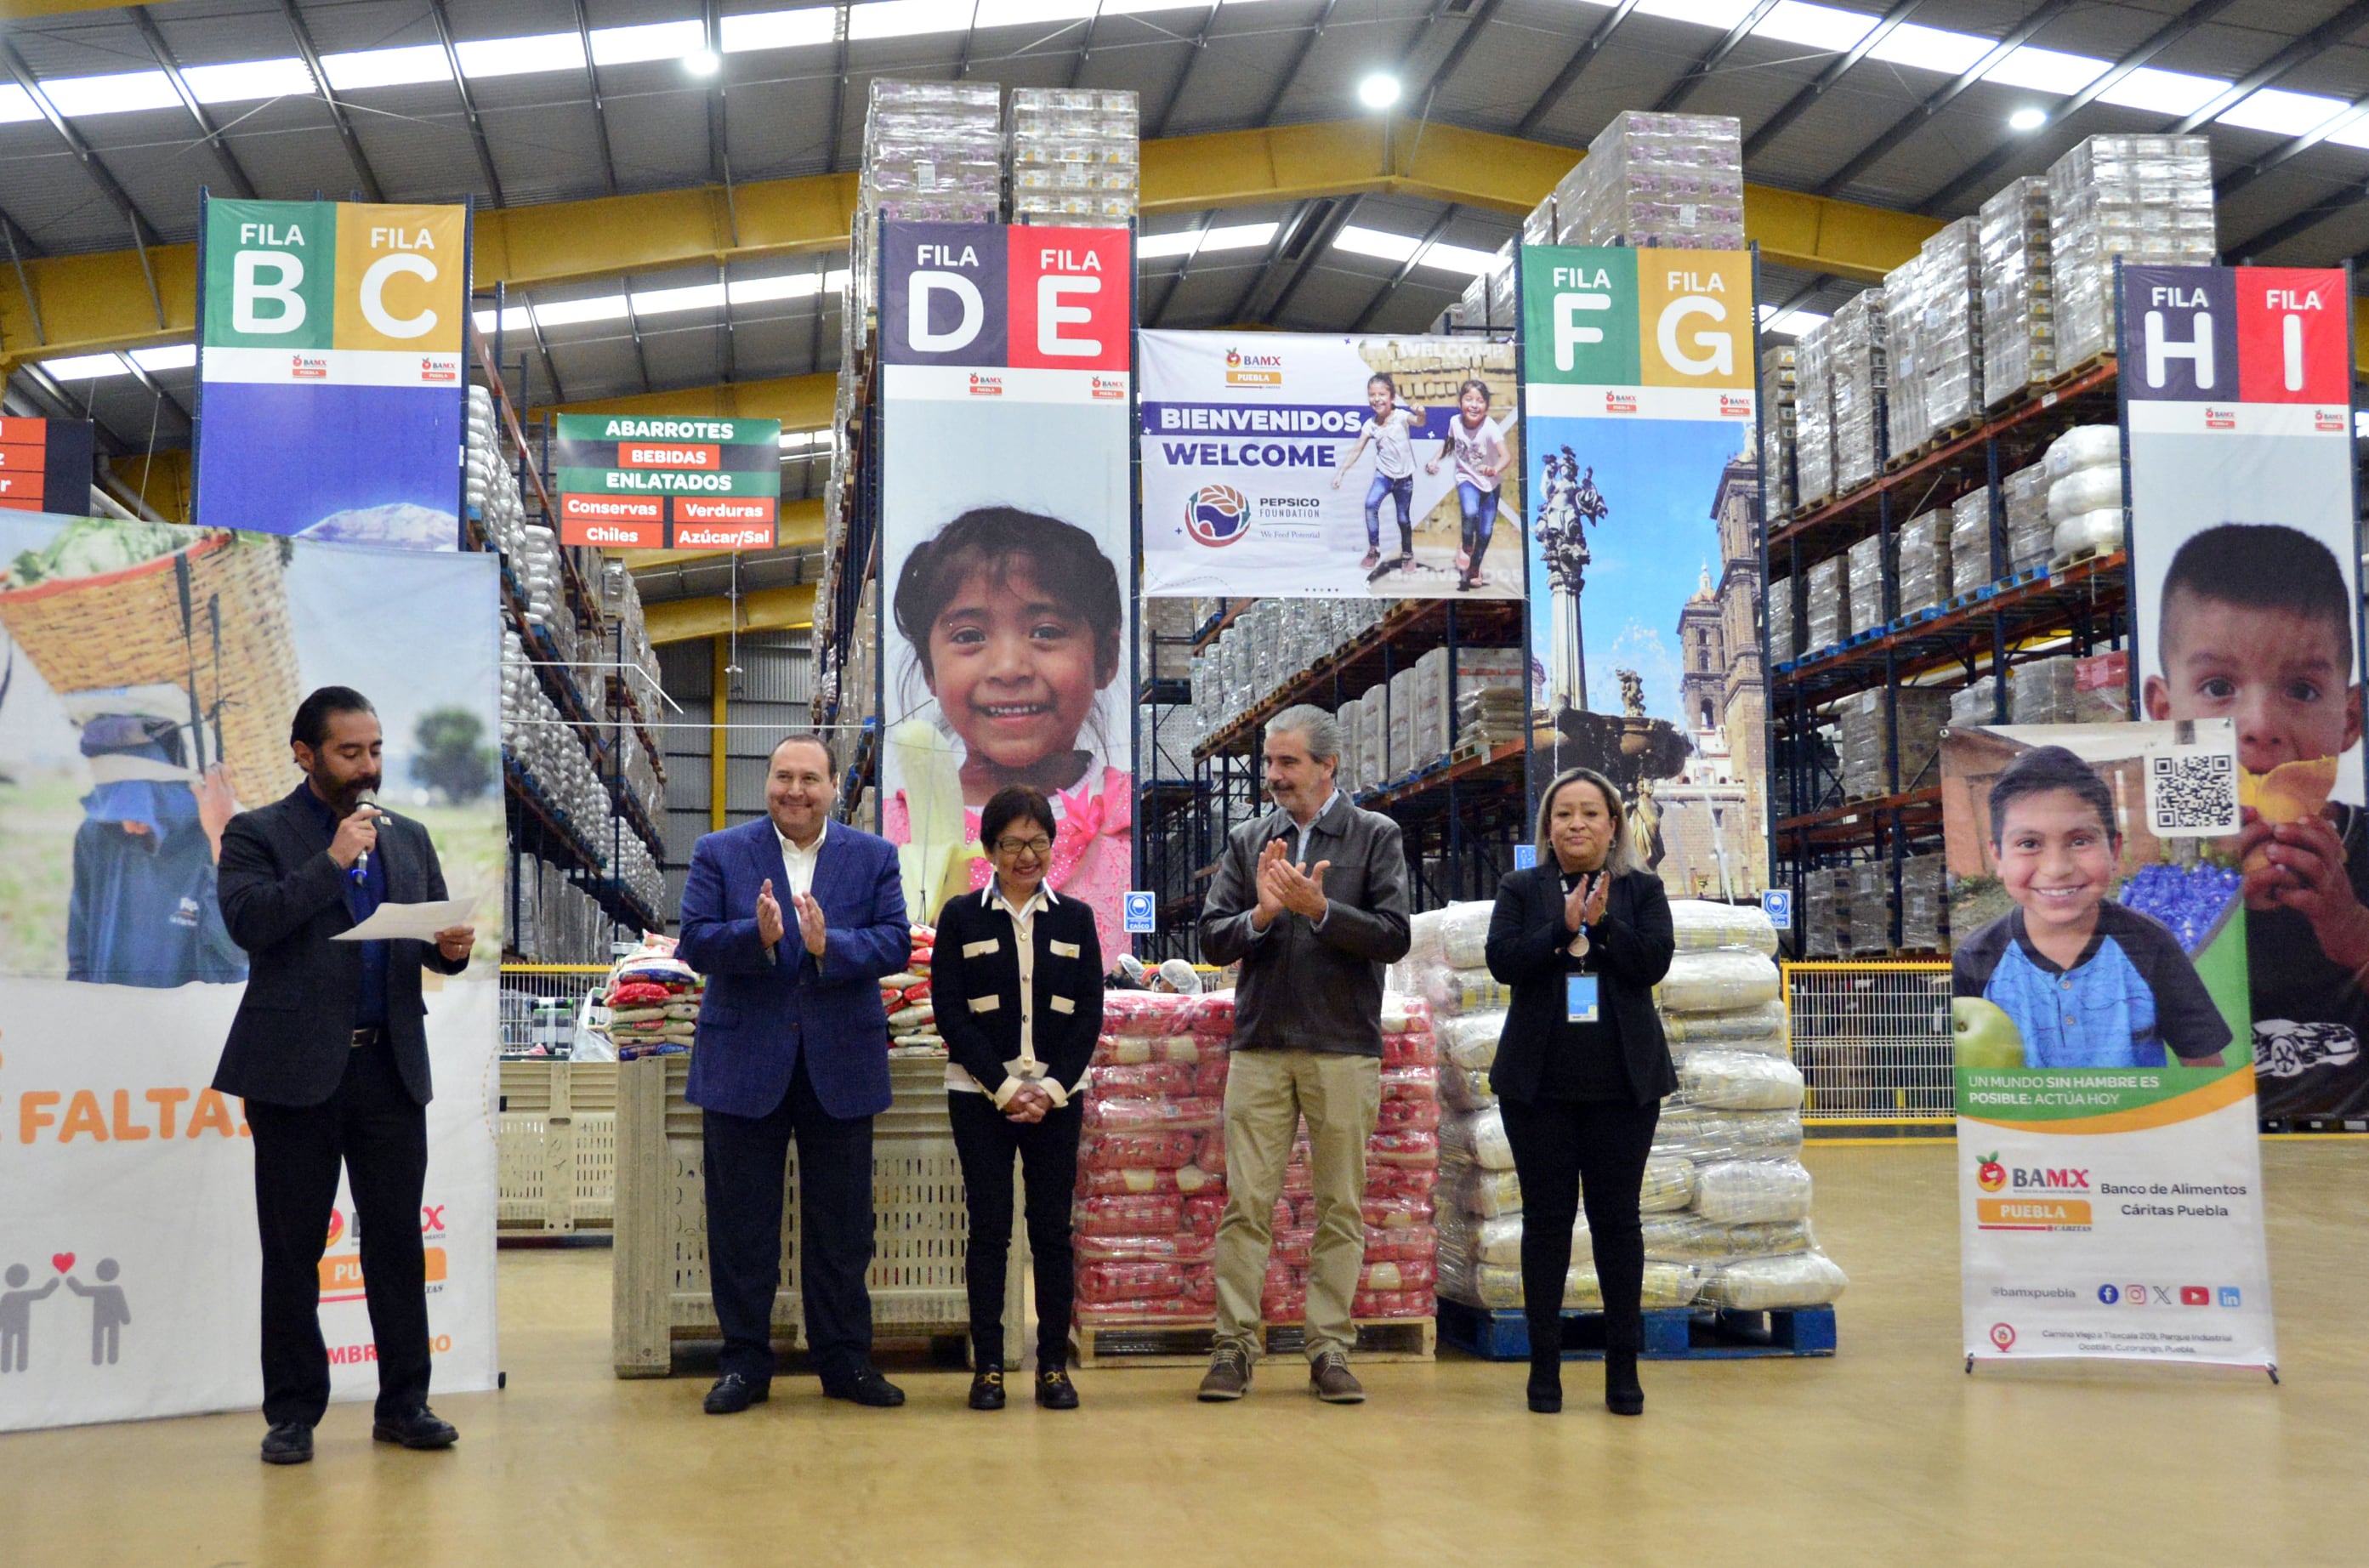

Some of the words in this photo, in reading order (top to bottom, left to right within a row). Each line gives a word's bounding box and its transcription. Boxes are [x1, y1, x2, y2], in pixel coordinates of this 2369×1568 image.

[240, 223, 304, 247] FILA
[371, 227, 435, 250] FILA
[917, 244, 979, 267] FILA
[1041, 249, 1101, 271] FILA
[1553, 267, 1611, 288] FILA
[1667, 271, 1725, 293] FILA
[232, 250, 307, 333] B
[360, 253, 437, 338] C
[2151, 287, 2209, 308] FILA
[2266, 289, 2322, 310] FILA
[908, 270, 984, 352] D
[1037, 275, 1102, 356] E
[1554, 293, 1611, 372] F
[1657, 294, 1733, 376] G
[2145, 310, 2214, 389] H
[2283, 314, 2303, 391] I
[1244, 355, 1281, 366] BAMX
[605, 420, 734, 439] ABARROTES
[1161, 408, 1361, 433] BIENVENIDOS
[632, 450, 707, 464] BEBIDAS
[1162, 442, 1336, 468] WELCOME
[606, 473, 732, 491] ENLATADOS
[567, 499, 657, 515] Conservas
[685, 503, 763, 518] Verduras
[1259, 497, 1320, 508] PEPSICO
[1259, 508, 1320, 518] FOUNDATION
[586, 526, 639, 542] Chiles
[679, 528, 770, 547] Azúcar/Sal
[1968, 1076, 1988, 1088] UN
[1991, 1076, 2044, 1088] MUNDO
[2047, 1077, 2071, 1088] SIN
[2073, 1077, 2137, 1088] HAMBRE
[2140, 1077, 2160, 1088] ES
[1968, 1093, 2031, 1105] POSIBLE:
[2034, 1091, 2088, 1105] ACTÚA
[2088, 1094, 2120, 1105] HOY
[2013, 1168, 2089, 1188] BAMX
[2100, 1183, 2145, 1195] Banco
[2149, 1183, 2167, 1195] de
[2171, 1184, 2247, 1195] Alimentos
[2001, 1204, 2066, 1219] PUEBLA
[2121, 1203, 2173, 1216] Cáritas
[2178, 1204, 2229, 1216] Puebla
[1991, 1286, 2076, 1300] @bamxpuebla
[2042, 1329, 2074, 1338] Camino
[2160, 1333, 2190, 1343] Parque
